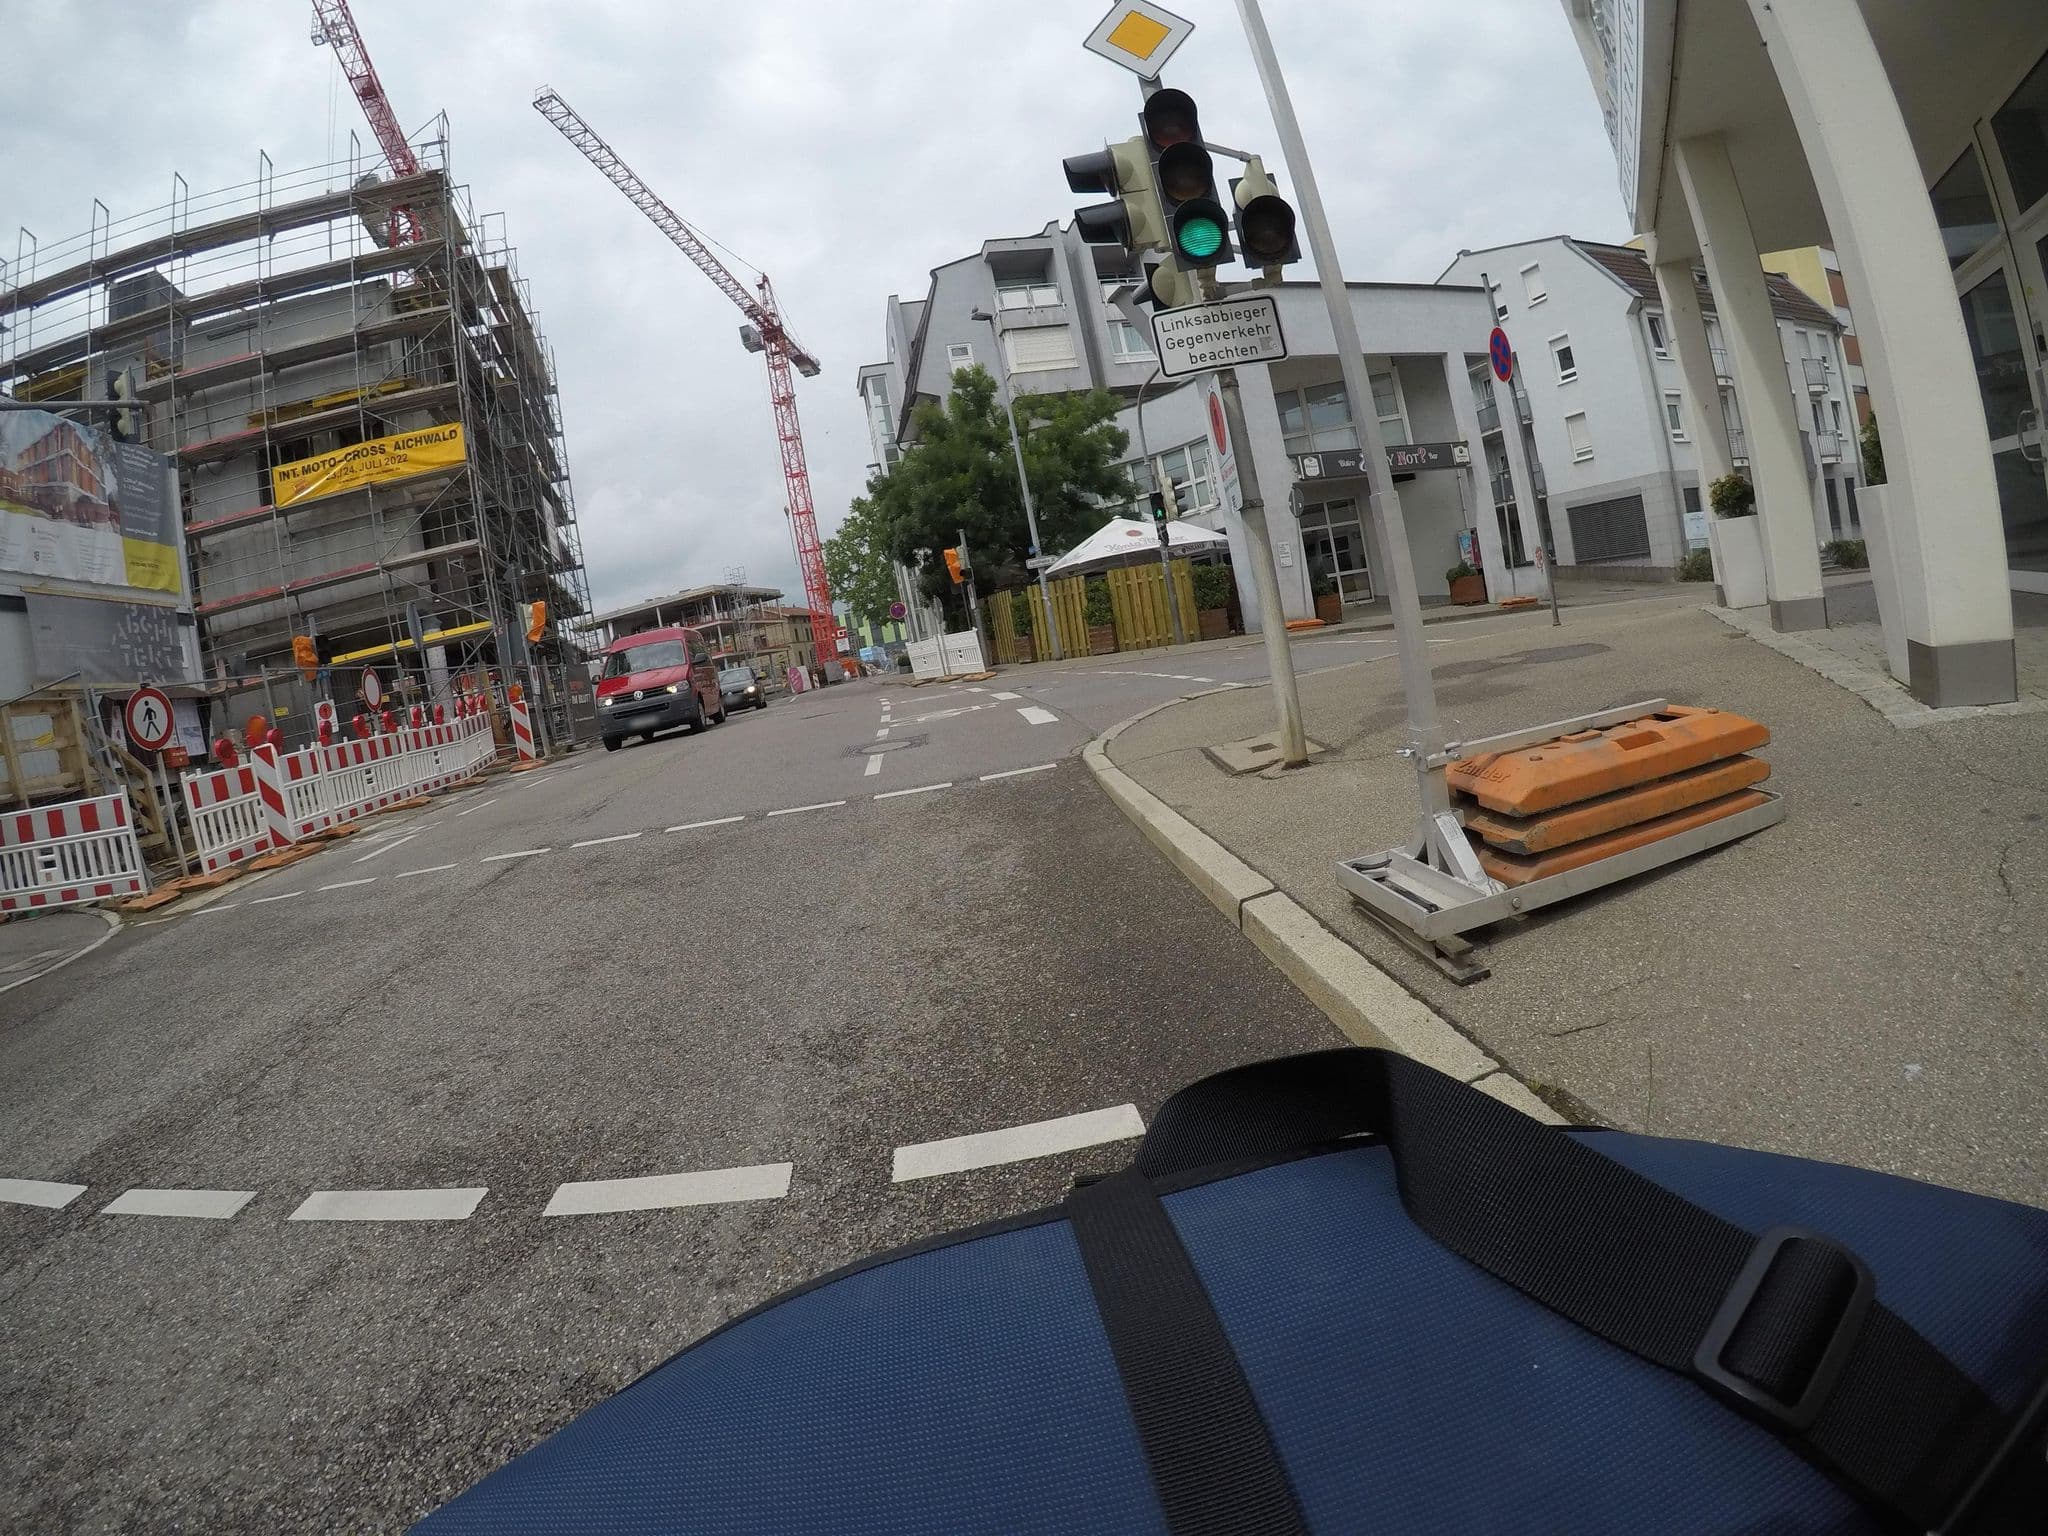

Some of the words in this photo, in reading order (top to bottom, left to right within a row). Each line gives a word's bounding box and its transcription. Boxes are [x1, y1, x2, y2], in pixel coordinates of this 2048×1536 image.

[1161, 306, 1267, 333] Linksabbieger
[1166, 324, 1271, 350] Gegenverkehr
[1189, 345, 1258, 365] beachten
[279, 466, 299, 482] INT.
[394, 429, 458, 451] AICHWALD
[359, 458, 383, 473] JULI
[384, 453, 409, 467] 2022
